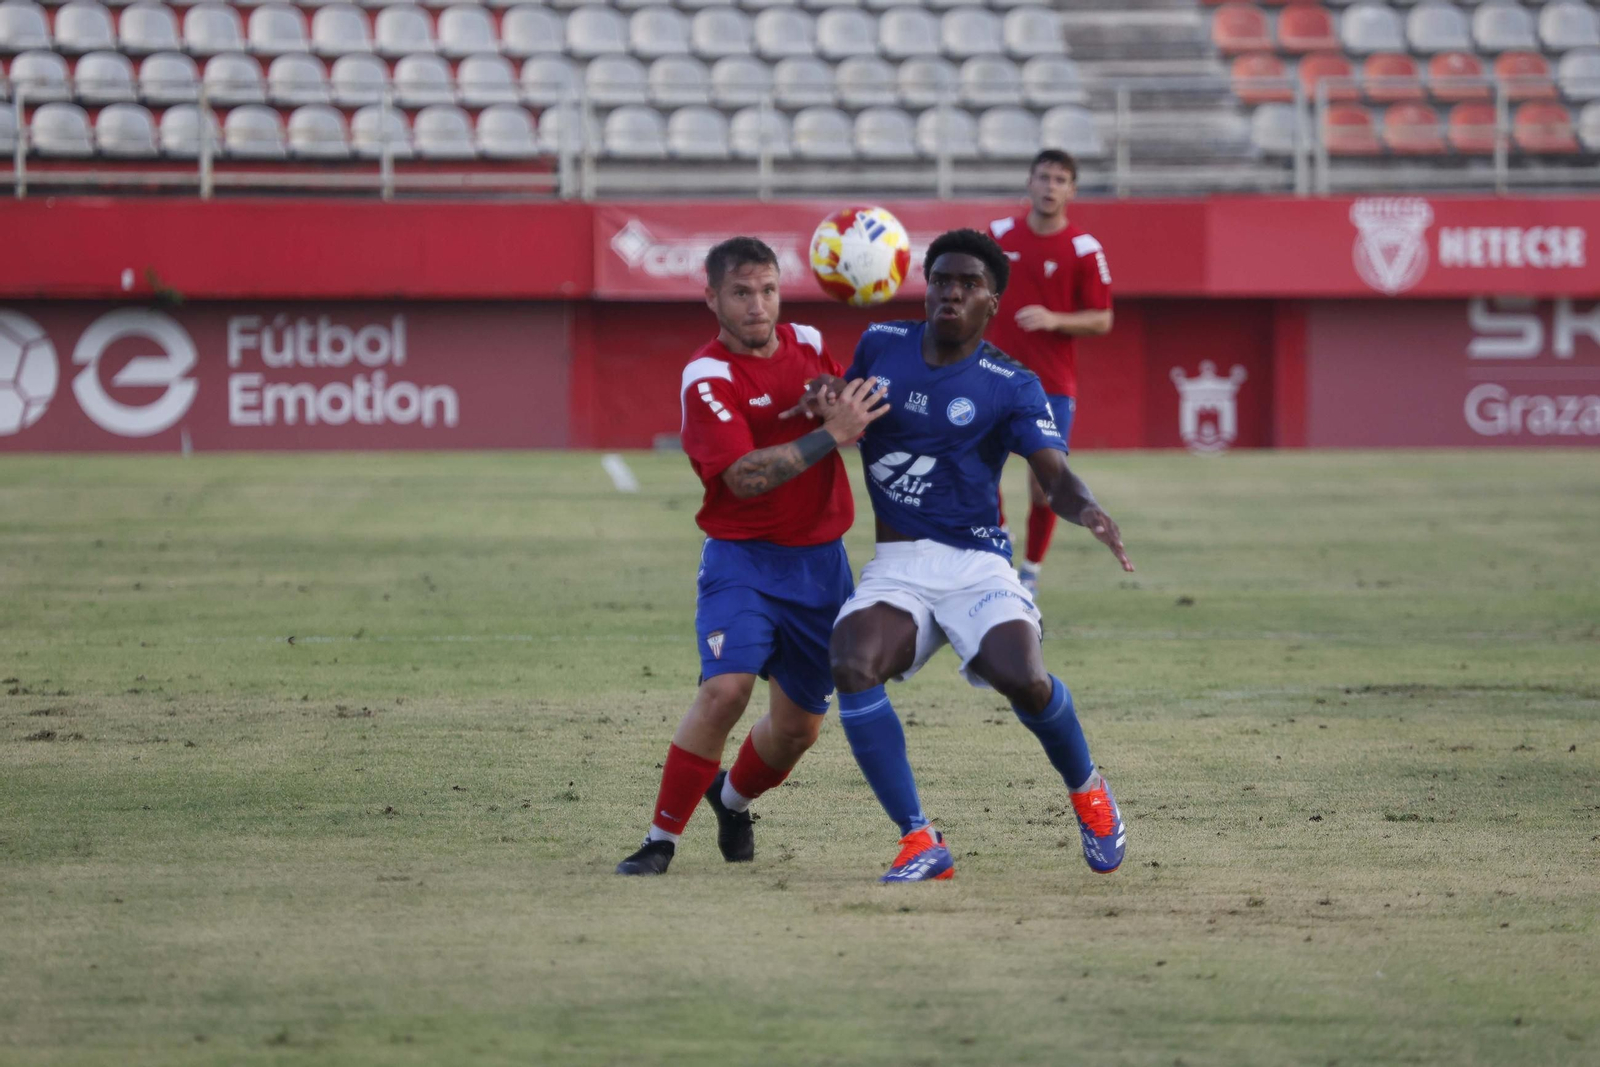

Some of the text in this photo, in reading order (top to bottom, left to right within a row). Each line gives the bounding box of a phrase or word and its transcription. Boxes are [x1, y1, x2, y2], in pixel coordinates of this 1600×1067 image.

[227, 314, 406, 367] Fútbol
[228, 370, 459, 427] Emotion
[889, 474, 932, 495] Air
